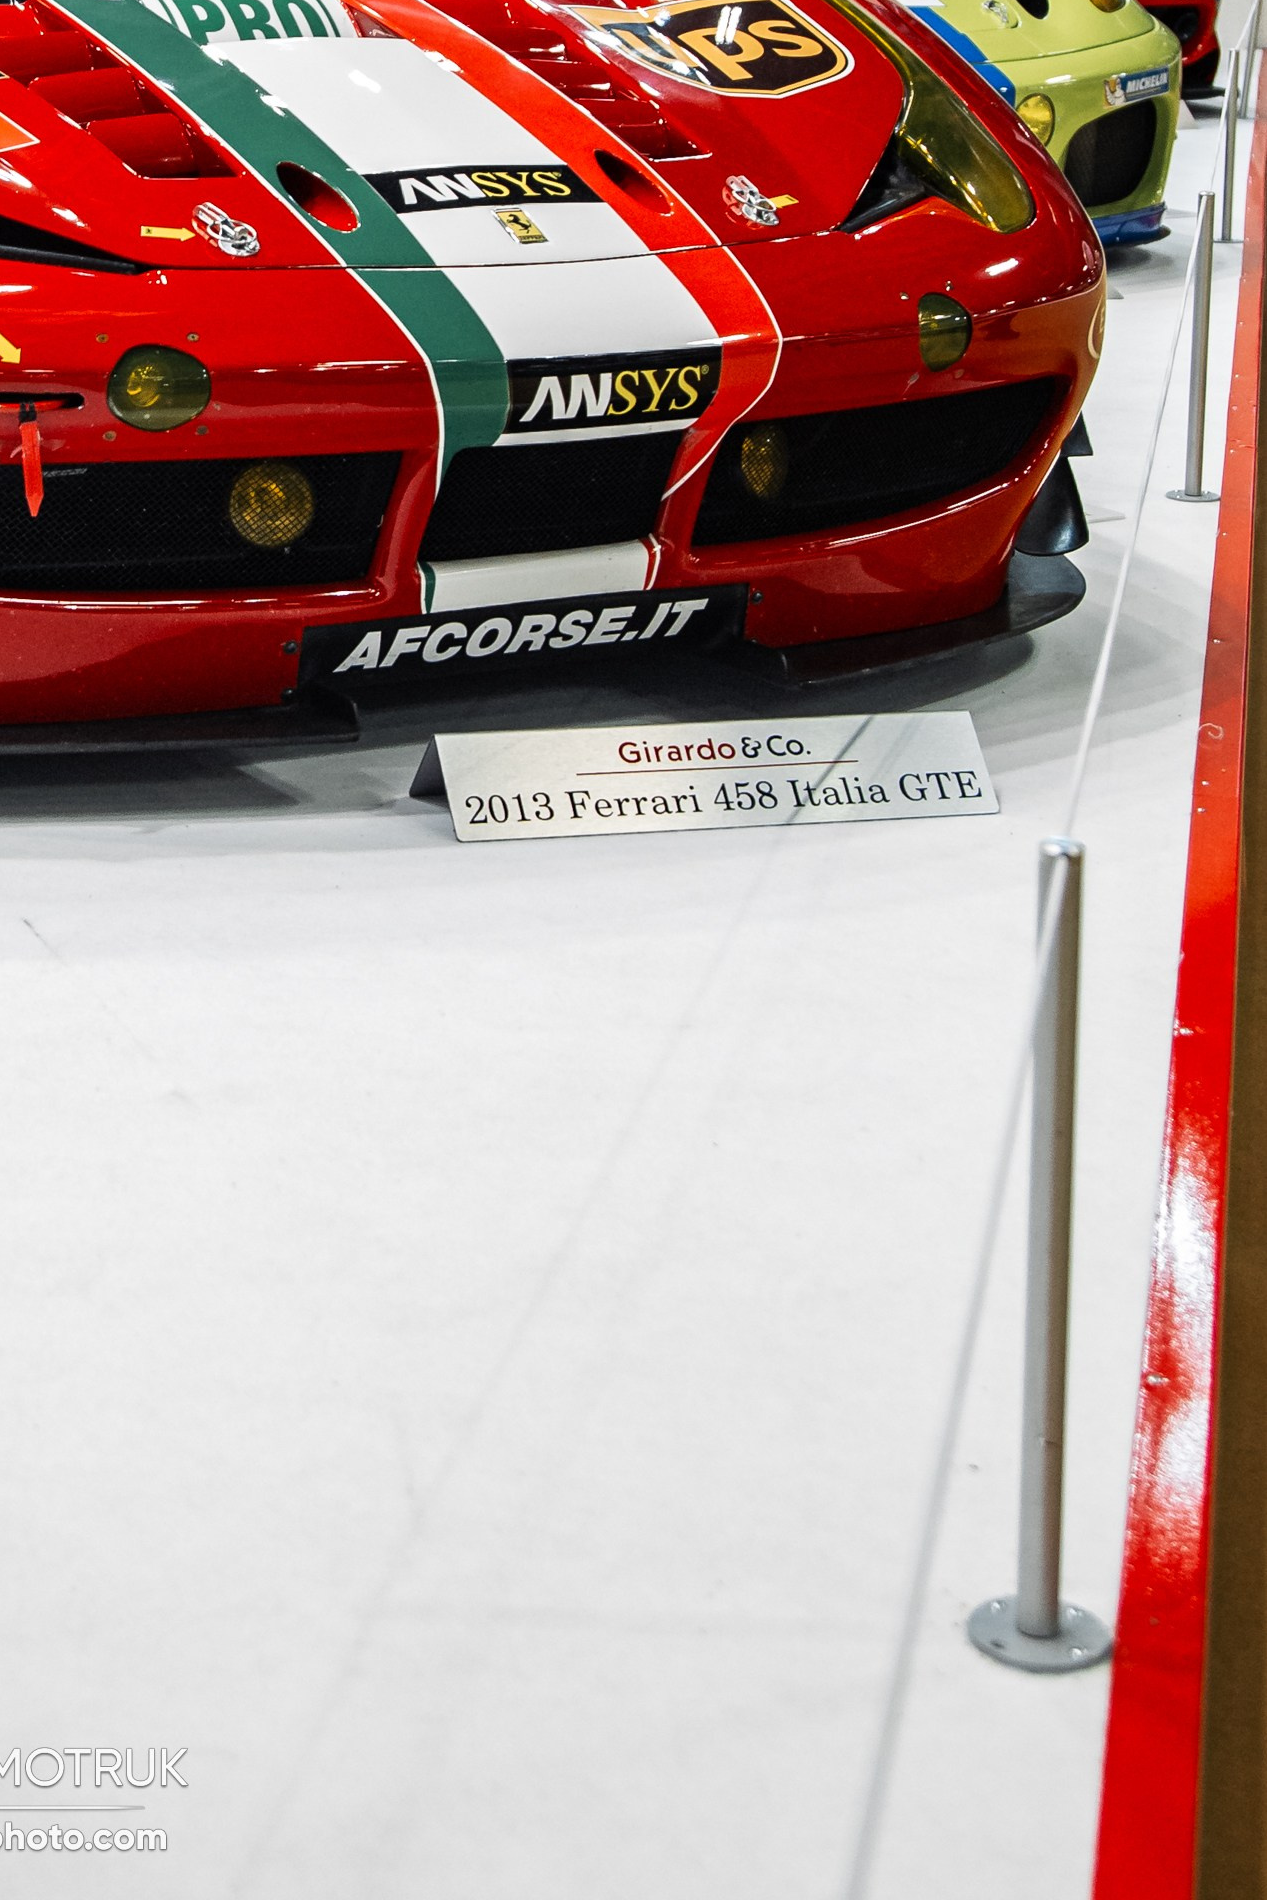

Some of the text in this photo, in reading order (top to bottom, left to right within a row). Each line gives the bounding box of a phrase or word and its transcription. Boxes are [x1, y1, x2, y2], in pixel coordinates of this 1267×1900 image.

[1125, 71, 1169, 94] MICHELIN
[398, 170, 568, 205] ANSYS
[519, 364, 706, 423] ANSYS
[332, 597, 710, 674] AFCORSE.IT
[618, 734, 812, 766] Girardo & Co.
[465, 770, 984, 825] 2013 Ferrari 458 Italia GTE
